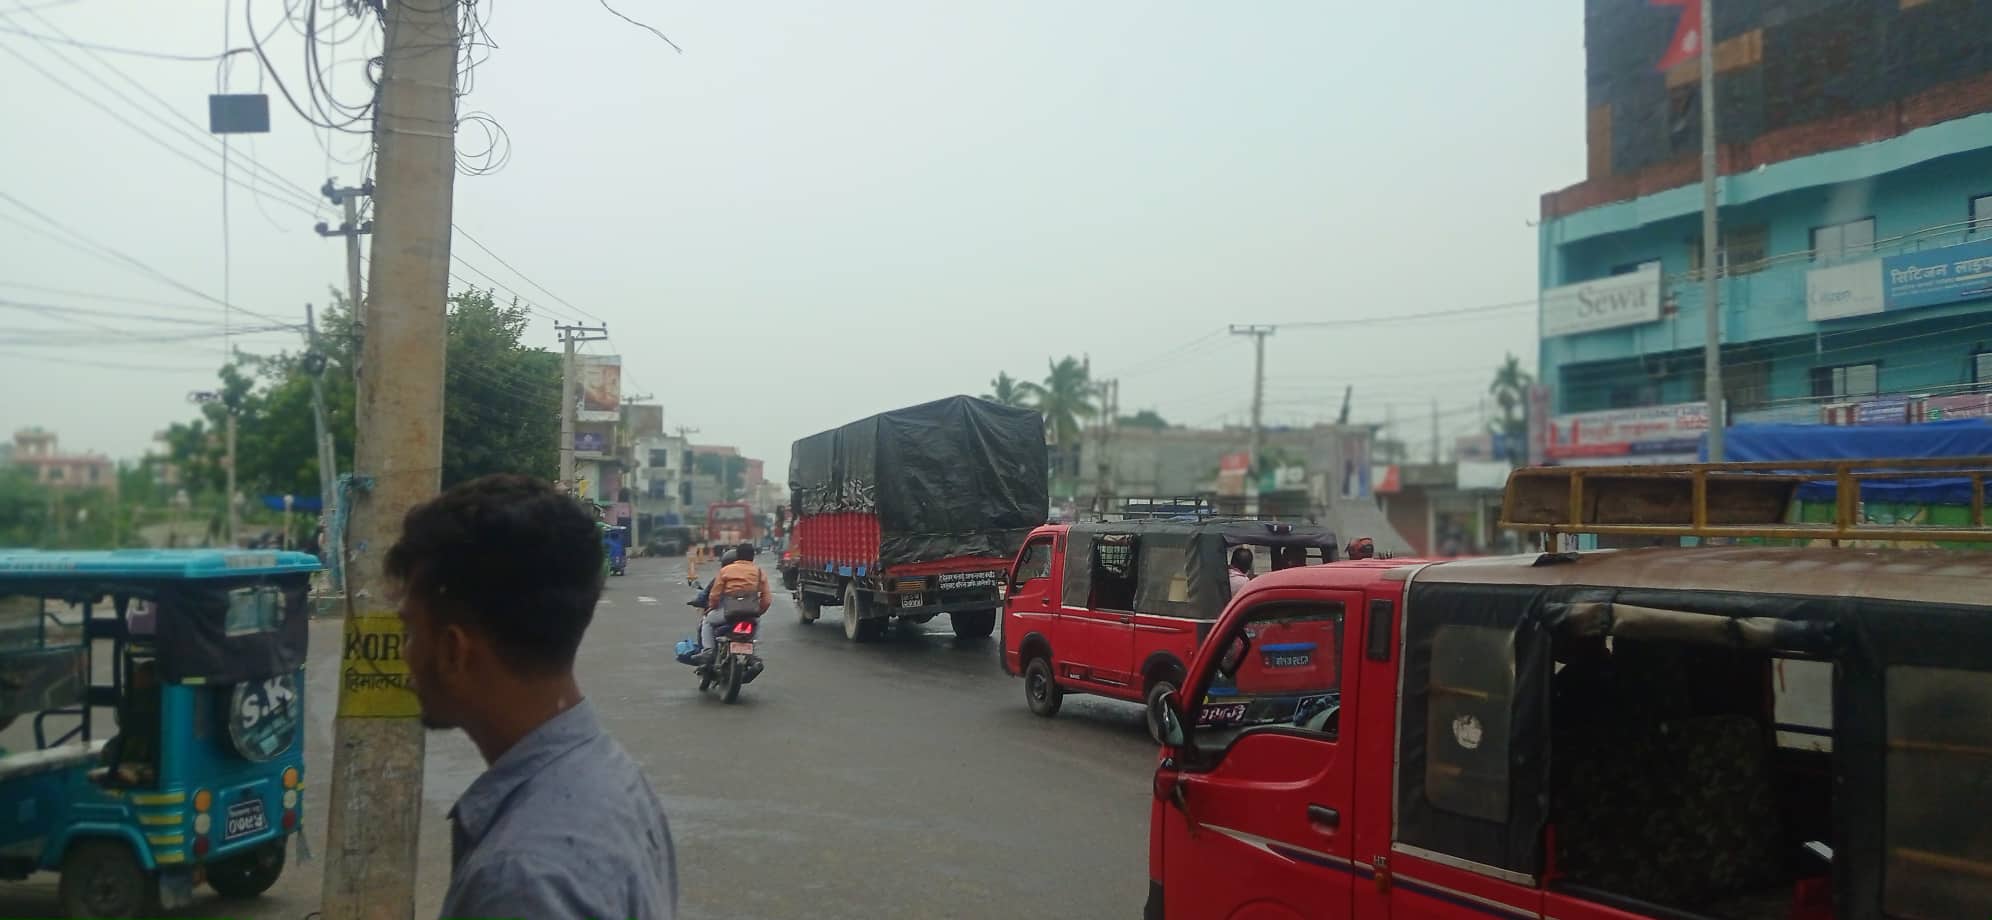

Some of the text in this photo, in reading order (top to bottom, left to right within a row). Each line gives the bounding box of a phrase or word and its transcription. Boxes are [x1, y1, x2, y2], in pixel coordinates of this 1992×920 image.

[1890, 264, 1949, 285] सिटिजन
[1576, 285, 1648, 318] Sewa
[241, 676, 292, 729] S.K
